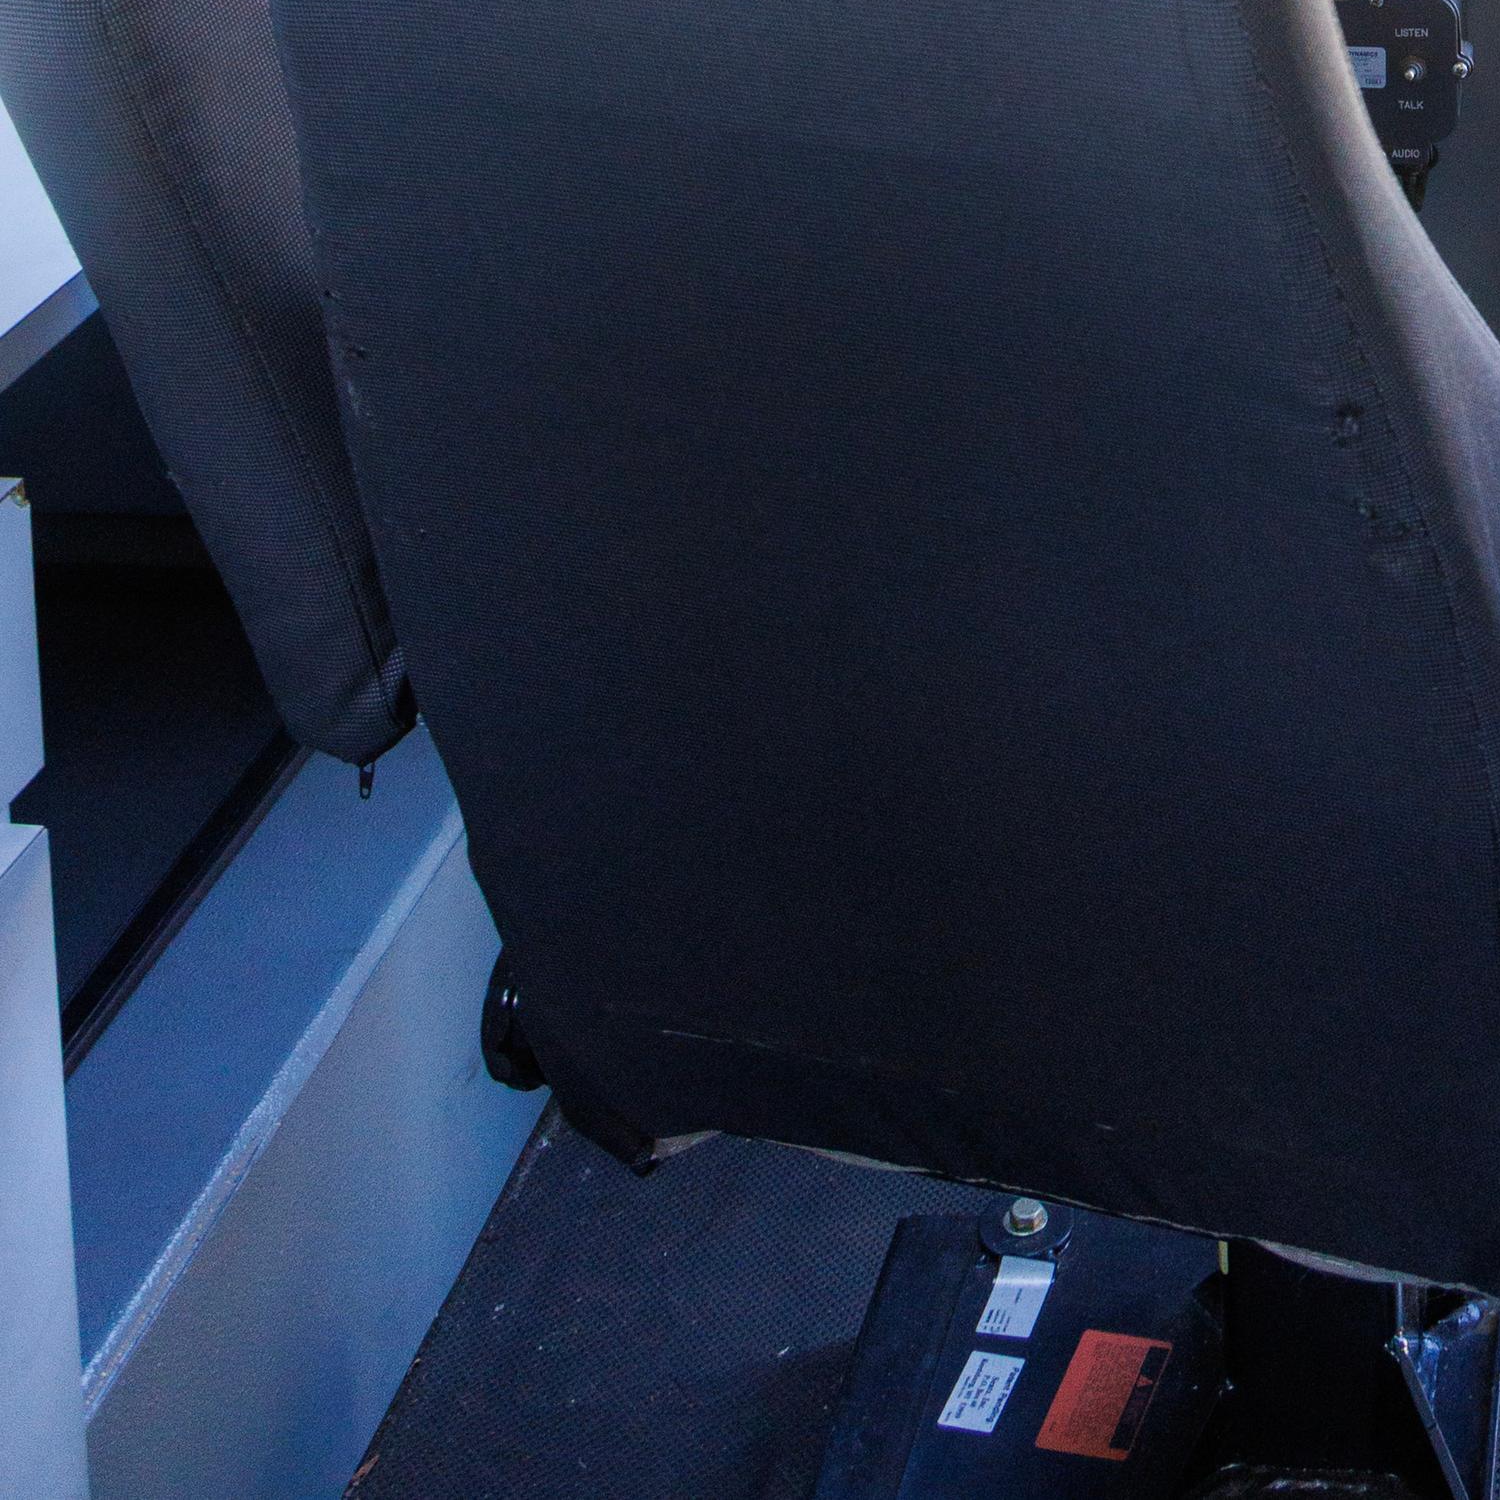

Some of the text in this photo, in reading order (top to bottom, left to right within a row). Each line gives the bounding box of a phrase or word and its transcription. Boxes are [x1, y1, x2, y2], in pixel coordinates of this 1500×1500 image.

[1395, 28, 1429, 38] LISTEN
[1398, 101, 1424, 110] TALK
[1392, 149, 1420, 158] AUDIO
